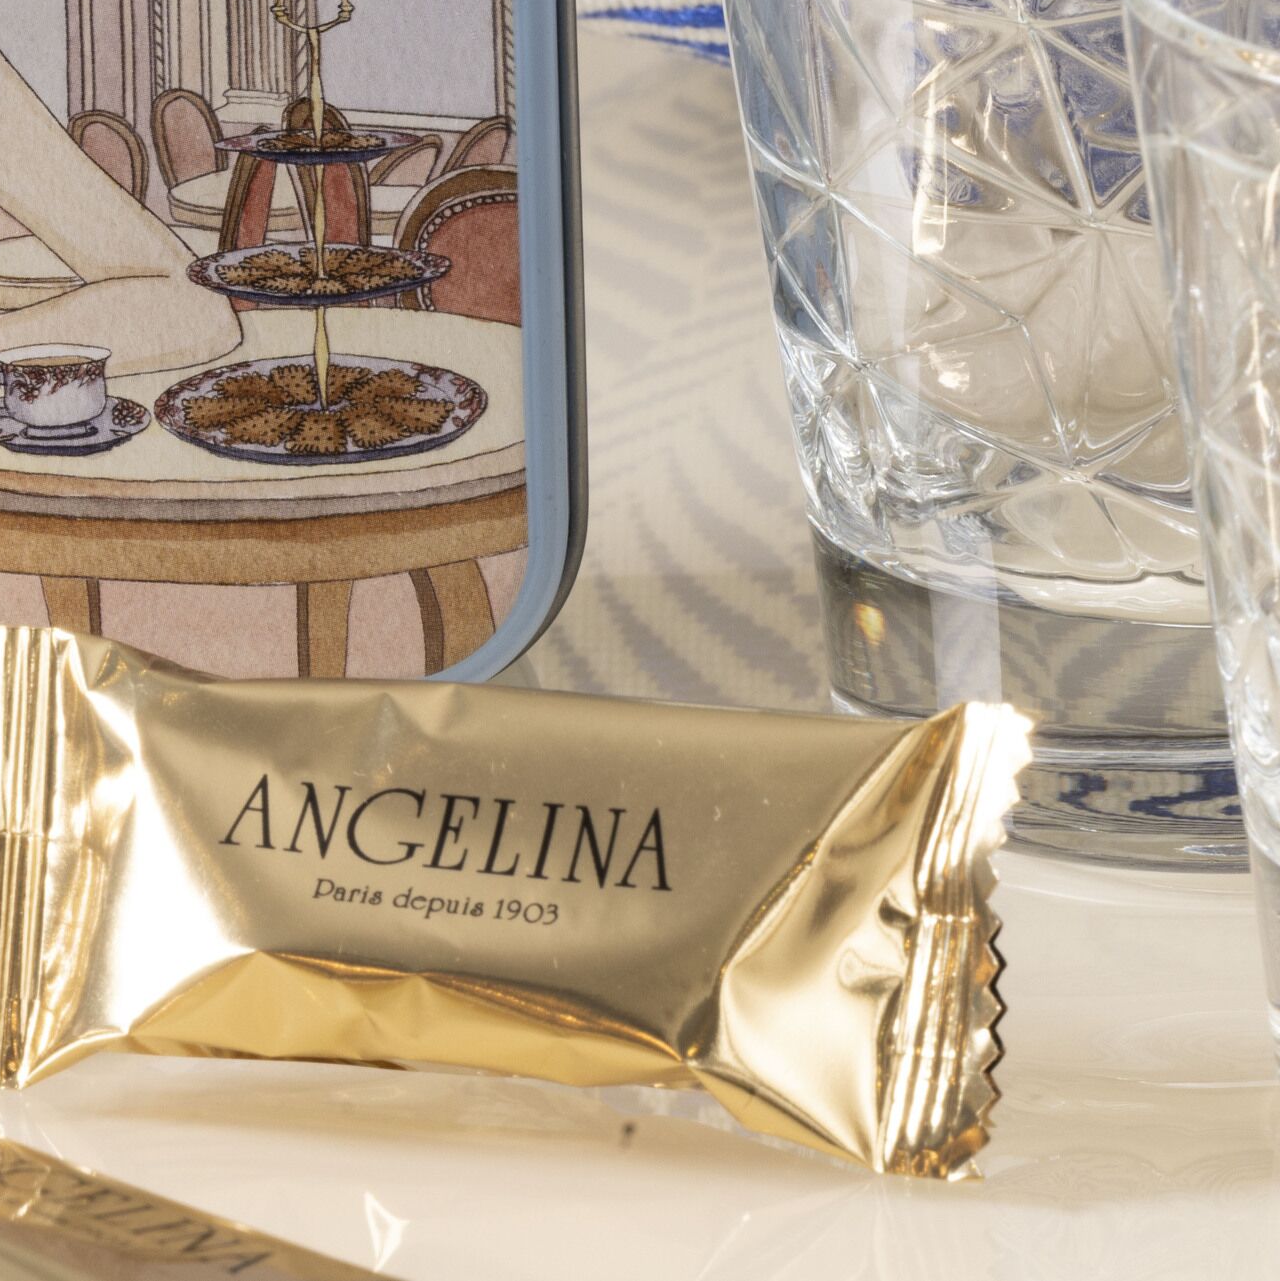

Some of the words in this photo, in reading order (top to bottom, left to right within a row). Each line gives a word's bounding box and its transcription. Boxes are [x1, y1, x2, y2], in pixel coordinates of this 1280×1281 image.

[218, 774, 673, 893] ANGELINA
[312, 877, 384, 906] Paris
[392, 887, 485, 920] depuis
[492, 898, 559, 926] 1903
